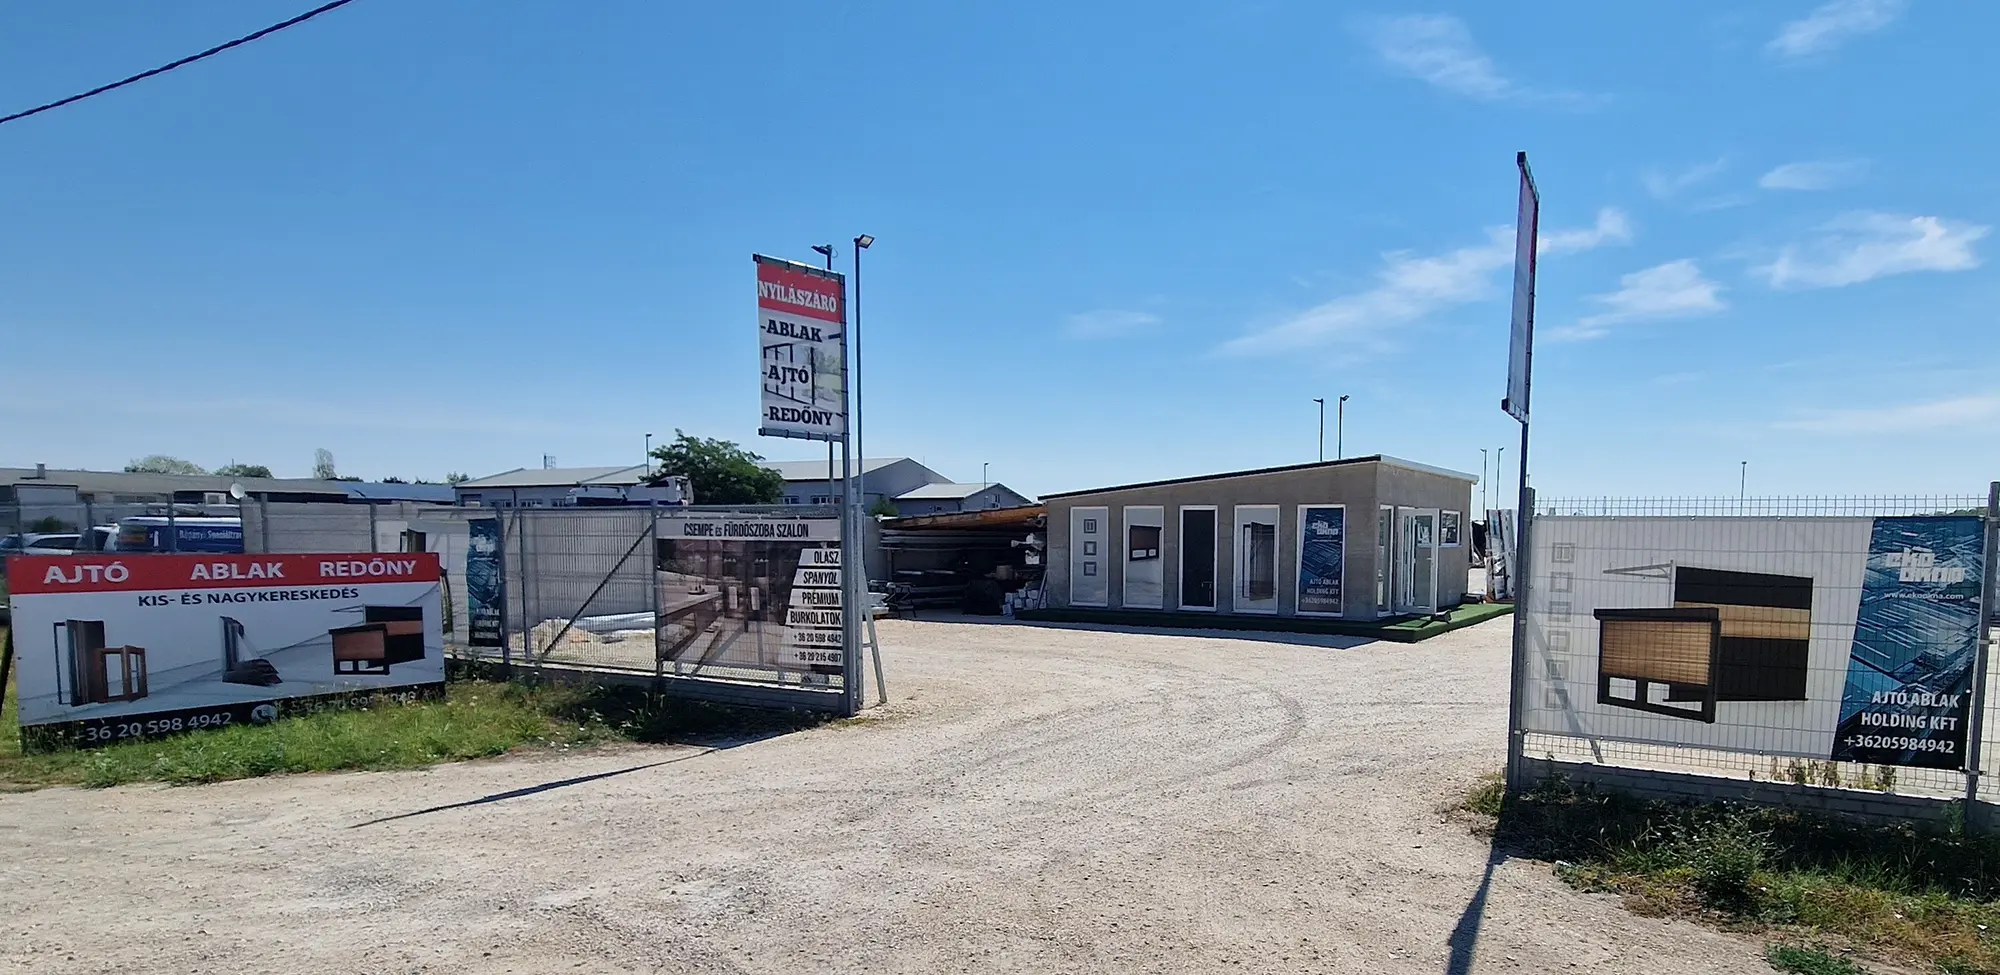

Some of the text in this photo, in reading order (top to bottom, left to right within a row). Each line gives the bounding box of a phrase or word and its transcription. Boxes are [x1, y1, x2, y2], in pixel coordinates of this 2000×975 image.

[758, 280, 837, 313] NYÍLÁSZÁRÓ
[684, 523, 714, 537] CSEMPE
[776, 524, 809, 538] SZALON
[814, 551, 839, 564] OLASZ
[43, 557, 417, 585] AJTÓ ABLAK REDŐNY
[803, 571, 838, 585] SPANYOL
[138, 587, 359, 607] KIS- ÉS NAGYKERESKEDÉS
[802, 590, 839, 605] PRÉMIUM
[790, 609, 841, 625] BURKOLATOK
[806, 632, 815, 643] 20
[815, 652, 827, 662] 215
[1871, 689, 1959, 708] AJTÓ ABLAK
[117, 722, 142, 738] 20
[147, 717, 183, 735] 598
[187, 712, 232, 729] 4942
[1861, 711, 1958, 731] HOLDING KFT
[1843, 733, 1955, 755] +36205984942
